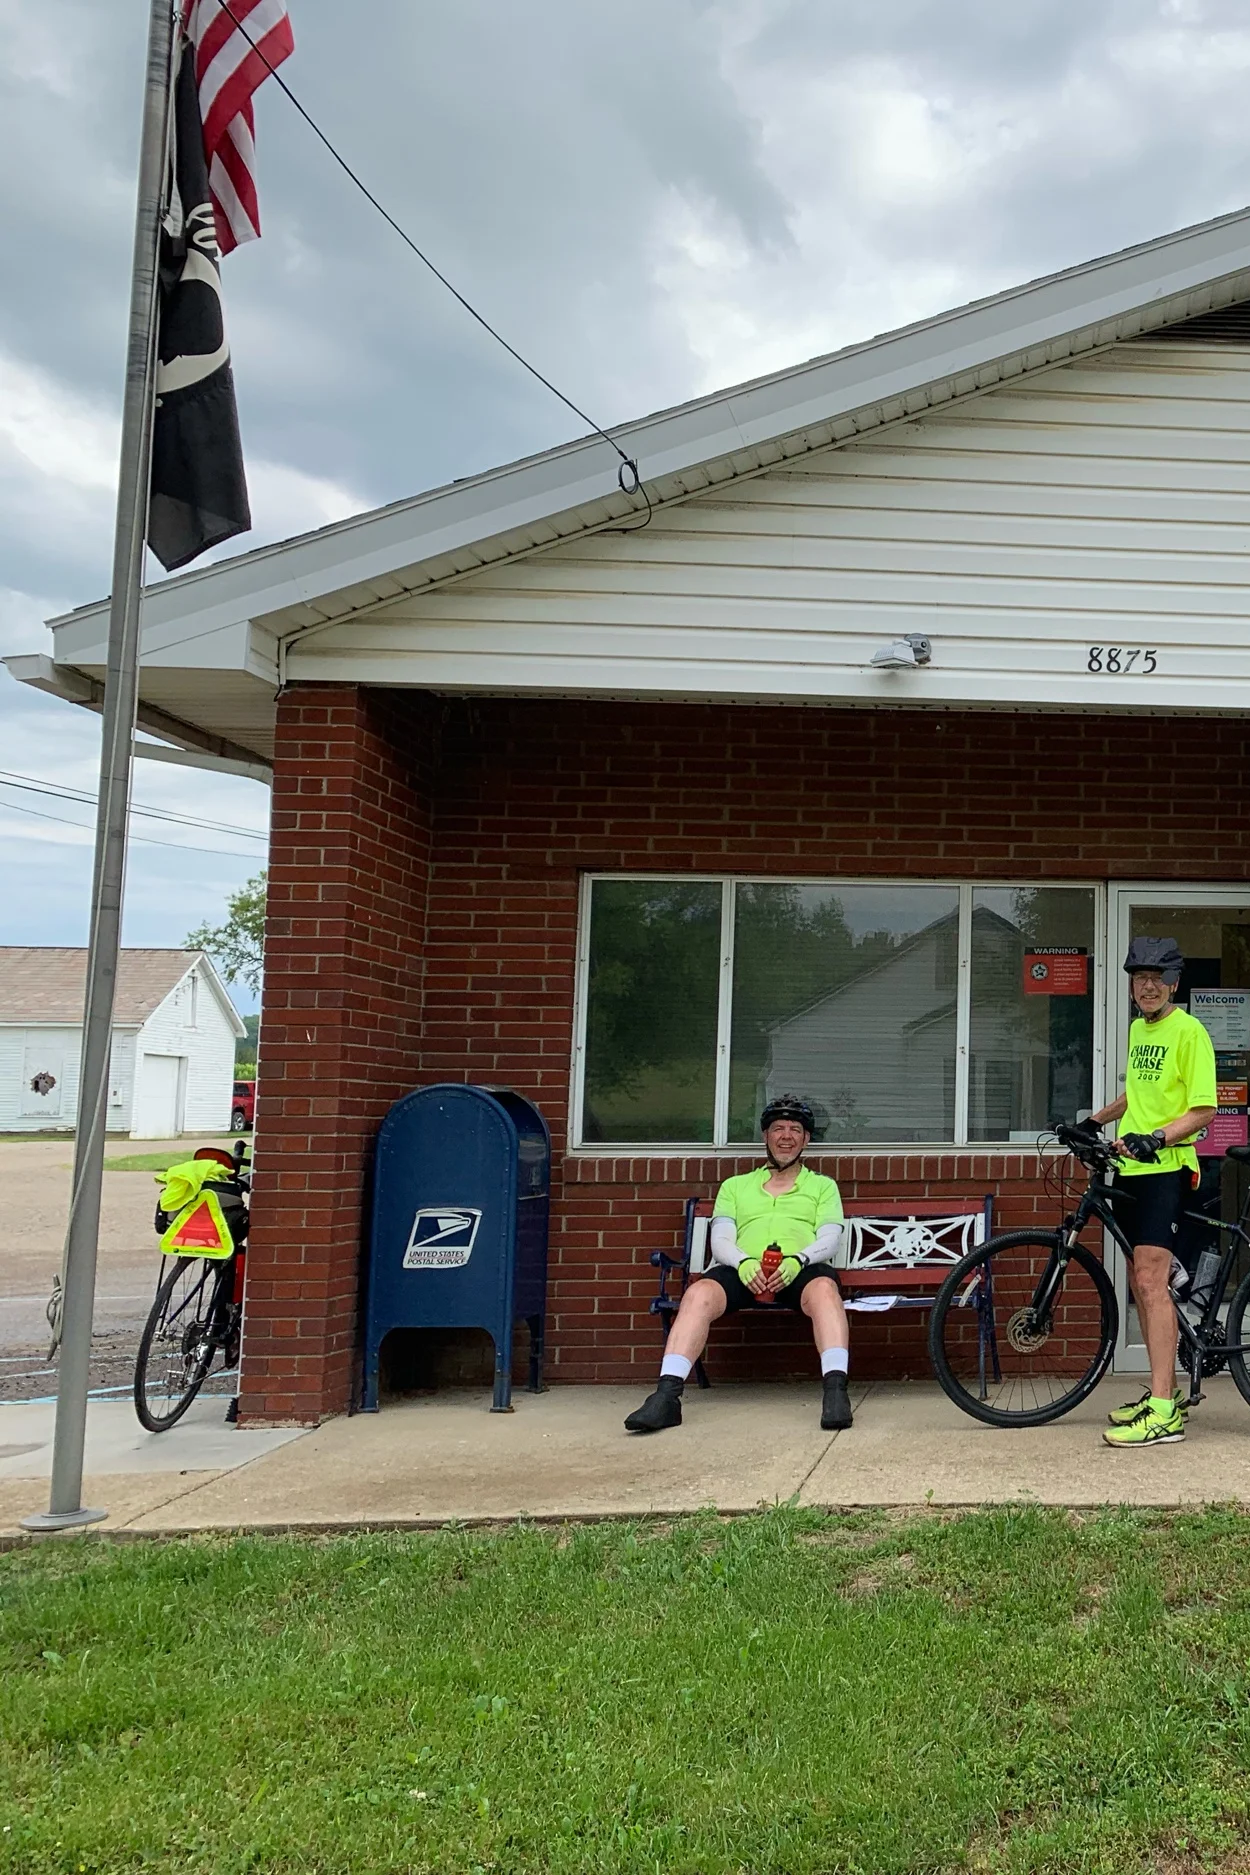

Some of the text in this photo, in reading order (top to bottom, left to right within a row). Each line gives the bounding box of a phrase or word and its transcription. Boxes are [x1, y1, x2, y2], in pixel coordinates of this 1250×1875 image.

[1087, 646, 1157, 674] 8875
[1194, 994, 1245, 1004] Welcome
[1132, 1056, 1165, 1071] CHASE
